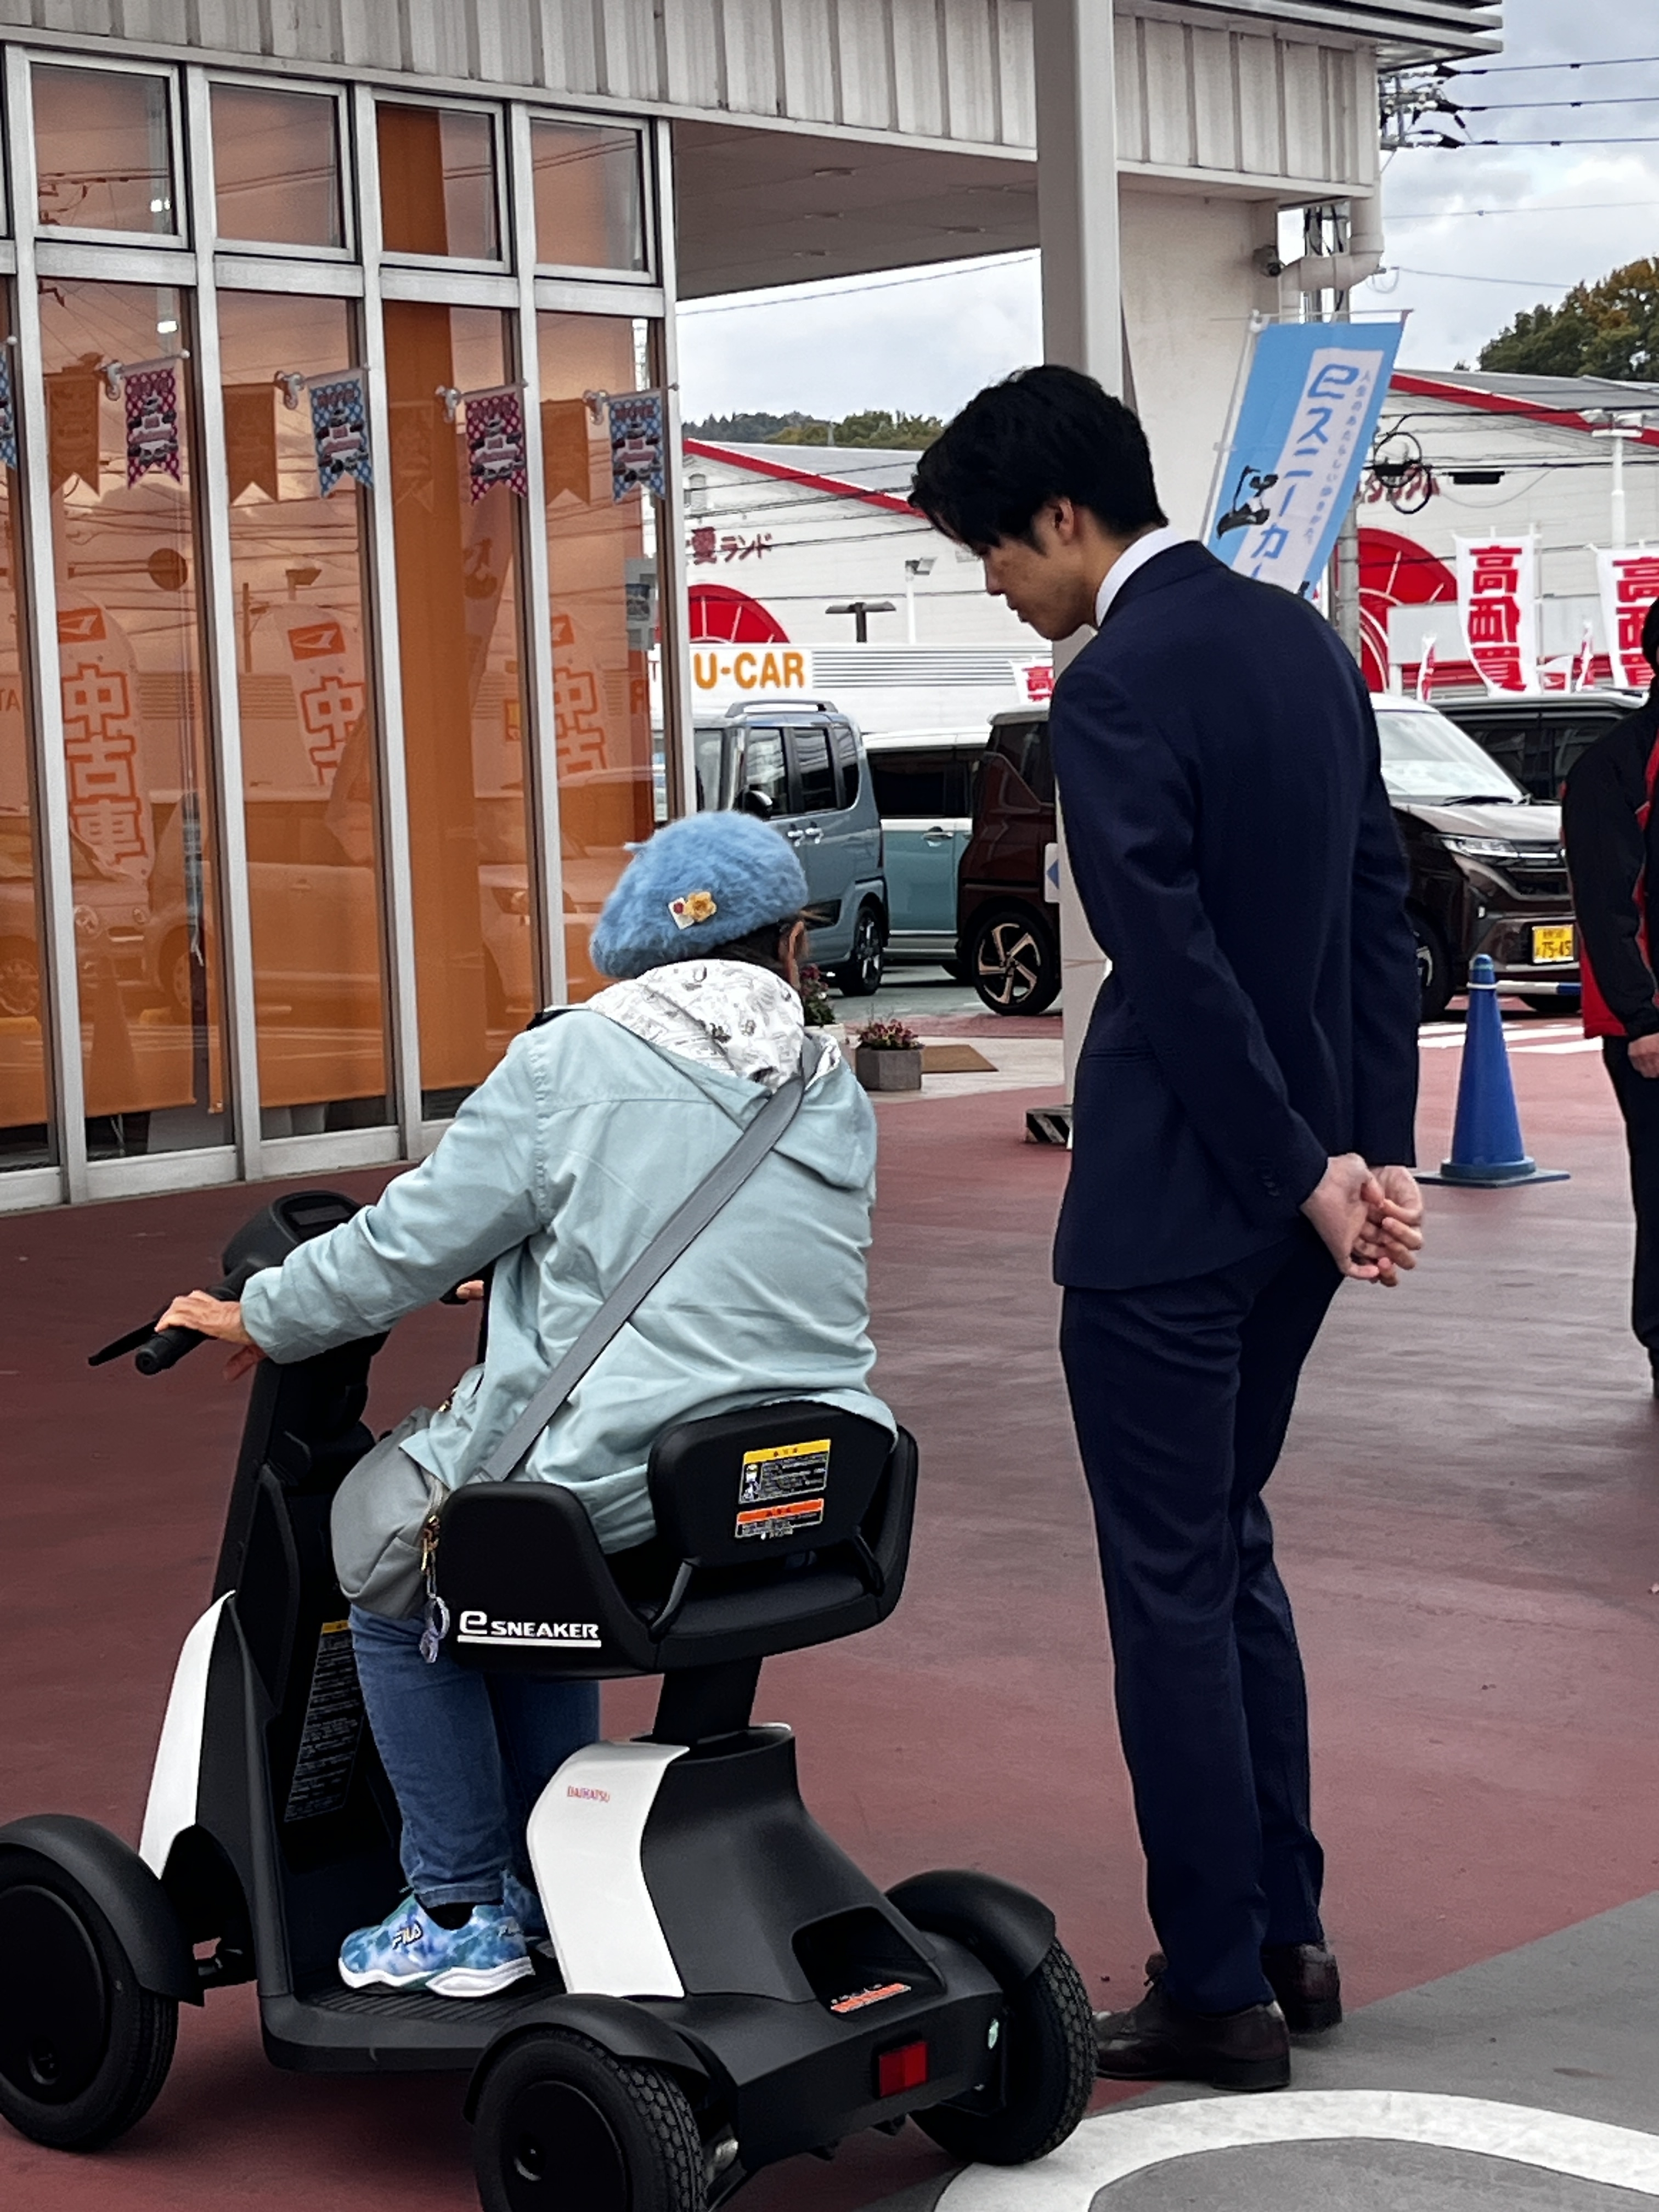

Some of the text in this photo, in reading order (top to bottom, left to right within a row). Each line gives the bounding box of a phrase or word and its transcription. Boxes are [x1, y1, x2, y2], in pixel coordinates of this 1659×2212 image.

[694, 652, 805, 689] U-CAR
[491, 1621, 599, 1639] SNEAKER
[392, 1922, 423, 1949] FILA
